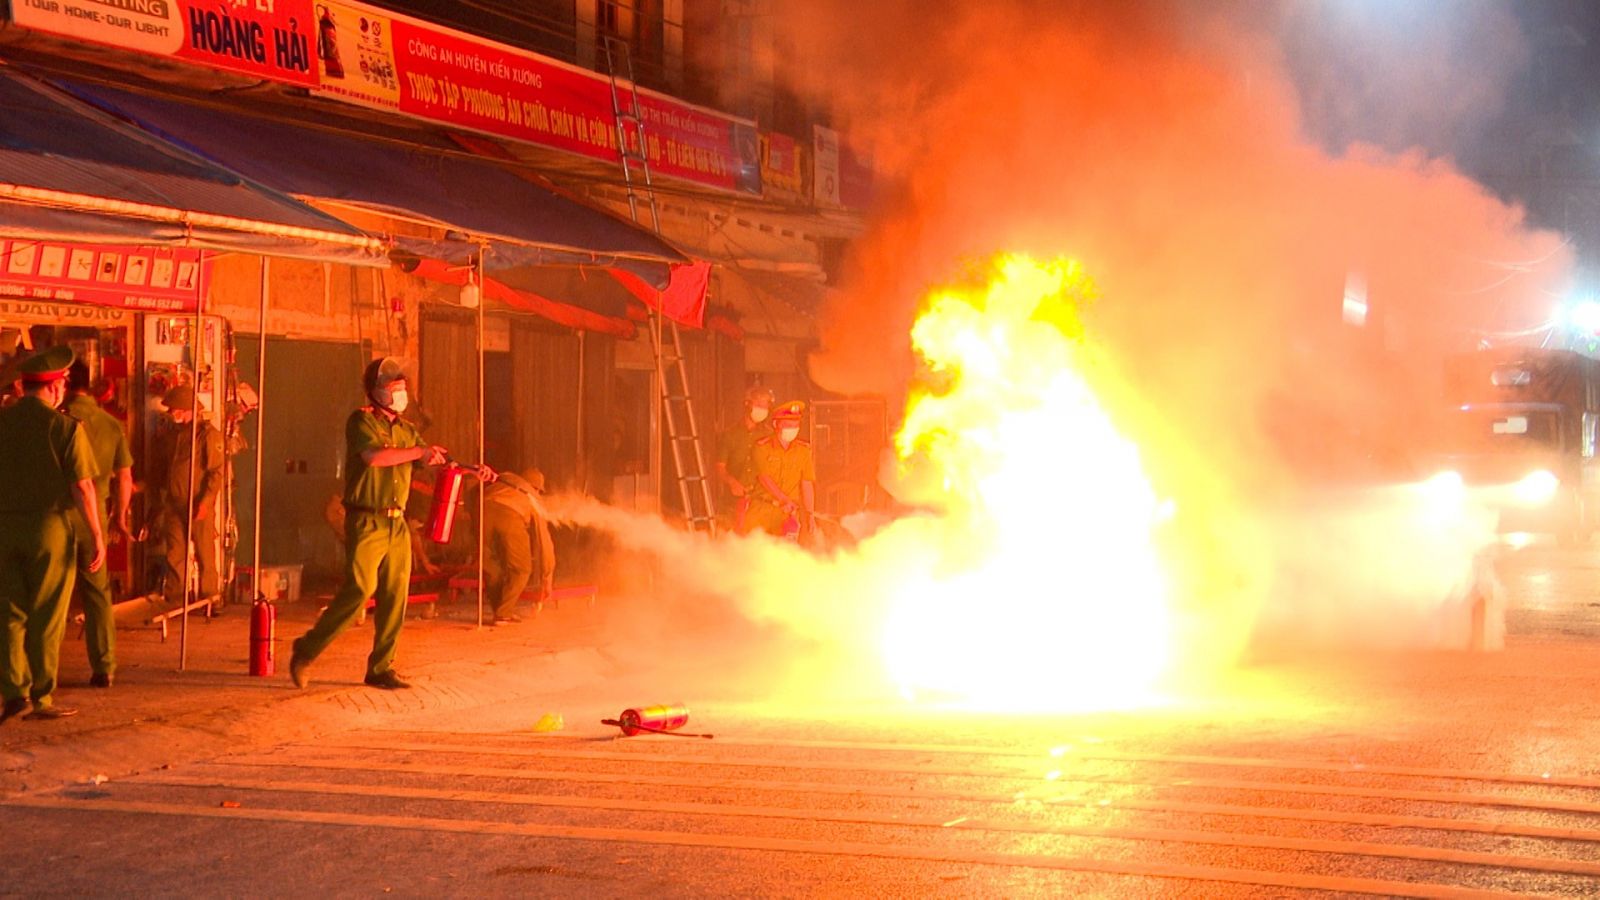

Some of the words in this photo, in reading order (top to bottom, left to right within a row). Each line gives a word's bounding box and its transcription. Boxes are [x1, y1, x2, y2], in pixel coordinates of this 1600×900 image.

[135, 22, 169, 37] LIGHT
[189, 5, 266, 65] HOÀNG
[274, 17, 310, 74] HẢI
[408, 37, 437, 60] CÔNG
[440, 47, 453, 65] AN
[455, 53, 487, 75] HUYỆN
[489, 59, 510, 80] KIẾN
[512, 67, 542, 89] XƯƠNG
[406, 71, 438, 109] THỰC
[438, 76, 460, 116] TẬP
[461, 86, 506, 121] PHƯƠNG
[507, 91, 522, 125] ÁN
[522, 100, 550, 133] CHỮA
[550, 105, 574, 139] CHÁY
[575, 112, 589, 143] VÀ
